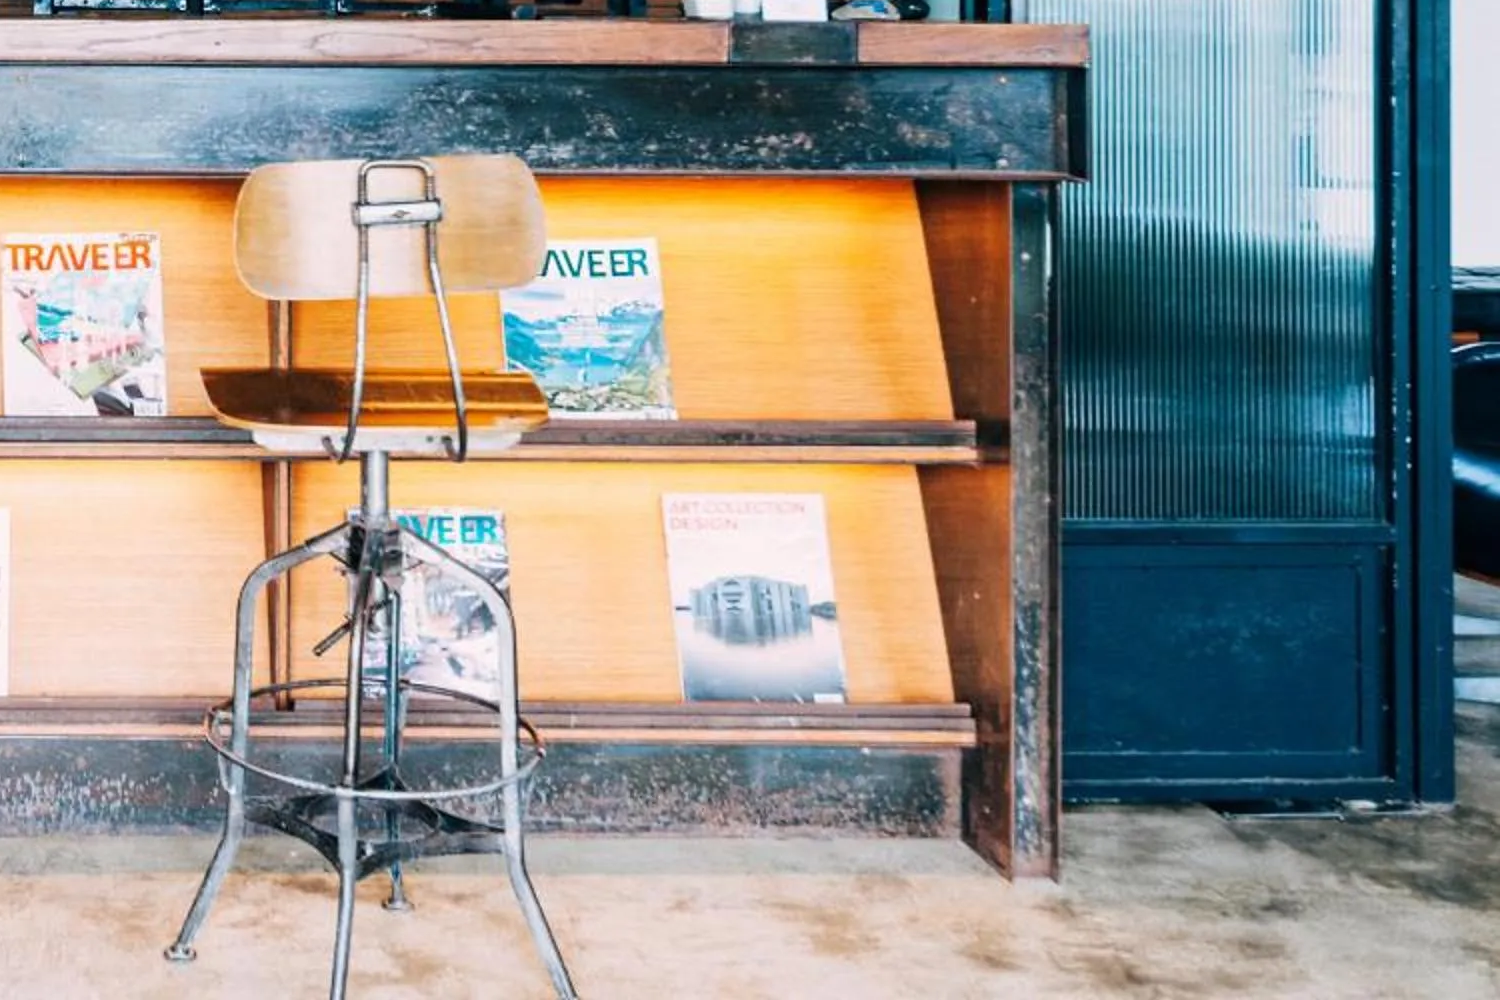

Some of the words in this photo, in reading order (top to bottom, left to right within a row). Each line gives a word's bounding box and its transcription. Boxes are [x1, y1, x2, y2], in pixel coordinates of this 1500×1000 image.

[537, 248, 649, 277] AVEER
[669, 501, 700, 514] ART
[703, 500, 805, 515] COLLECTION
[670, 517, 738, 531] DESIGN
